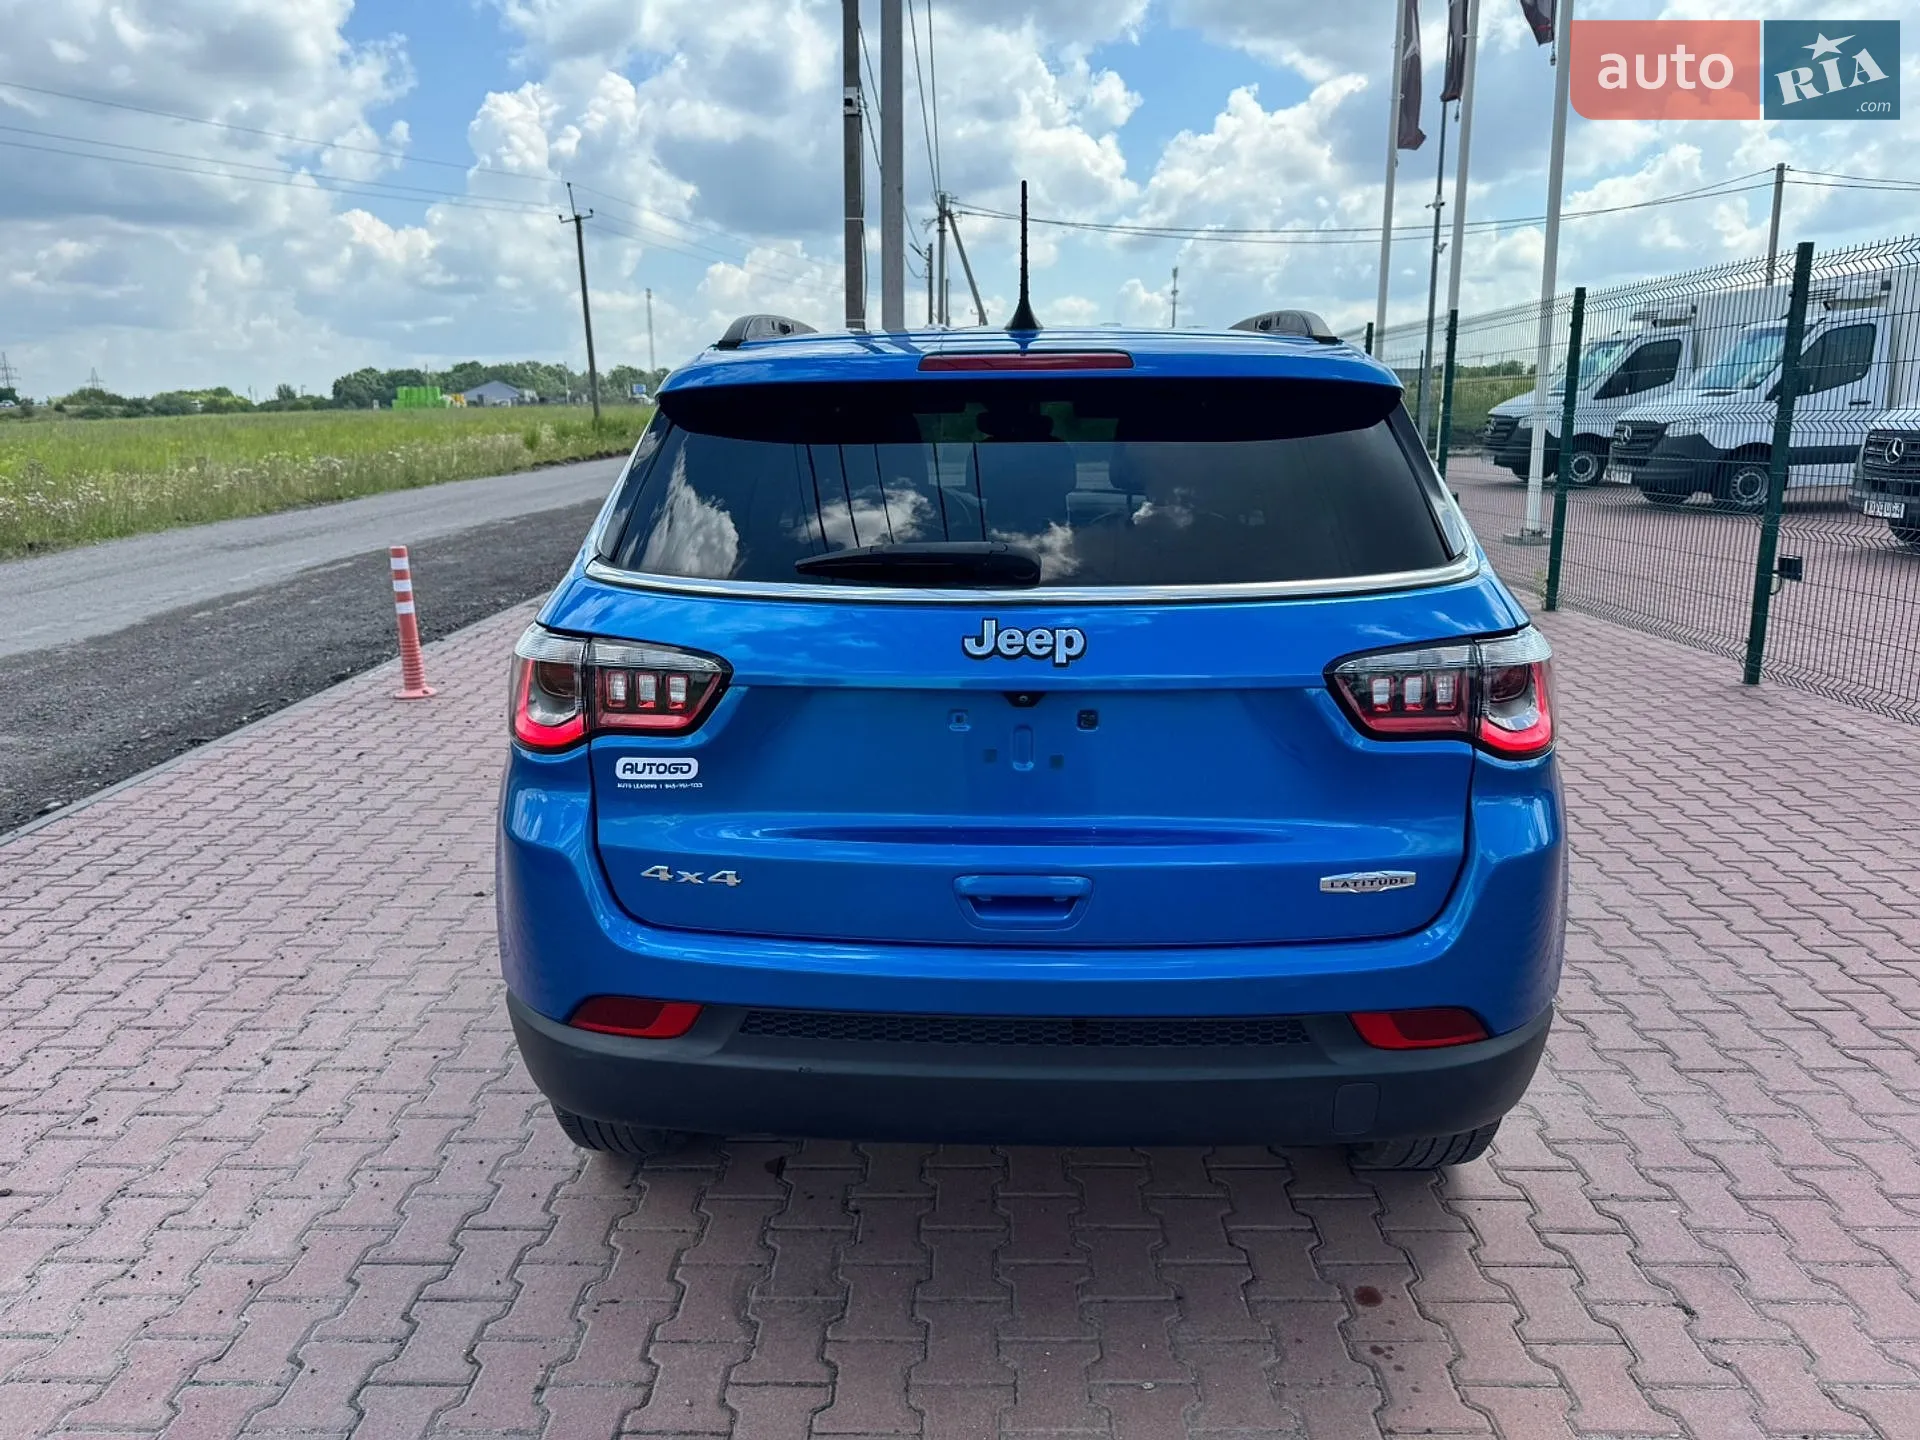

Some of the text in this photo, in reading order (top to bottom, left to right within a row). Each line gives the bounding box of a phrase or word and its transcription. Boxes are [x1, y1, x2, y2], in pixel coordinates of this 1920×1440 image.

[963, 619, 1086, 664] Jeep
[640, 865, 742, 886] 4x4
[1330, 877, 1408, 889] LATITUDE
